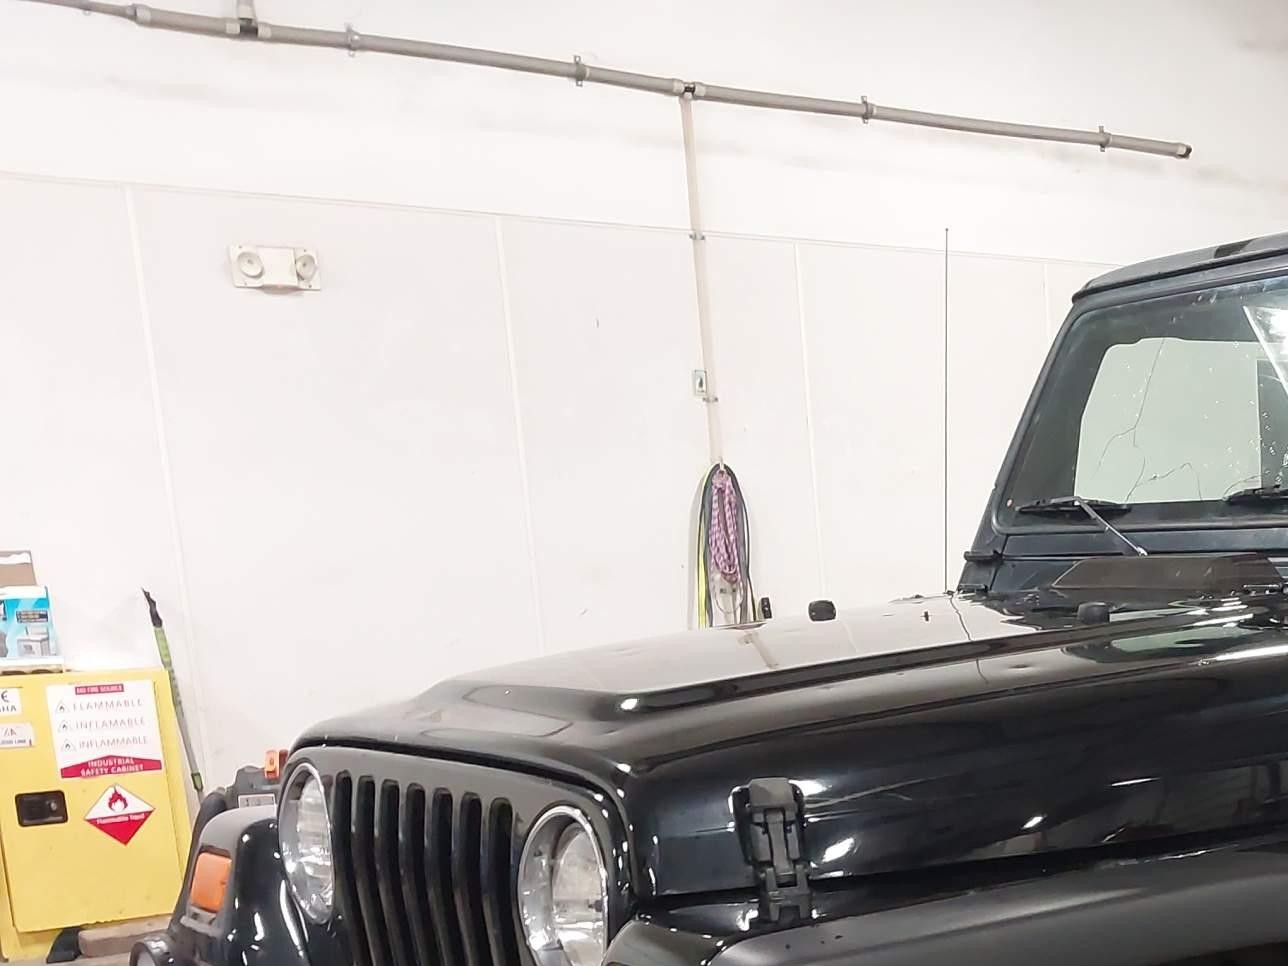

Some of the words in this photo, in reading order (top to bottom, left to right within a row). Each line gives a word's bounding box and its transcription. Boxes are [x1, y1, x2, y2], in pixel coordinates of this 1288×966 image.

[73, 698, 143, 712] FLAMMABLE
[88, 758, 135, 768] INDUSTRIAL
[80, 766, 109, 777] SAFETY
[111, 764, 144, 774] CABINET
